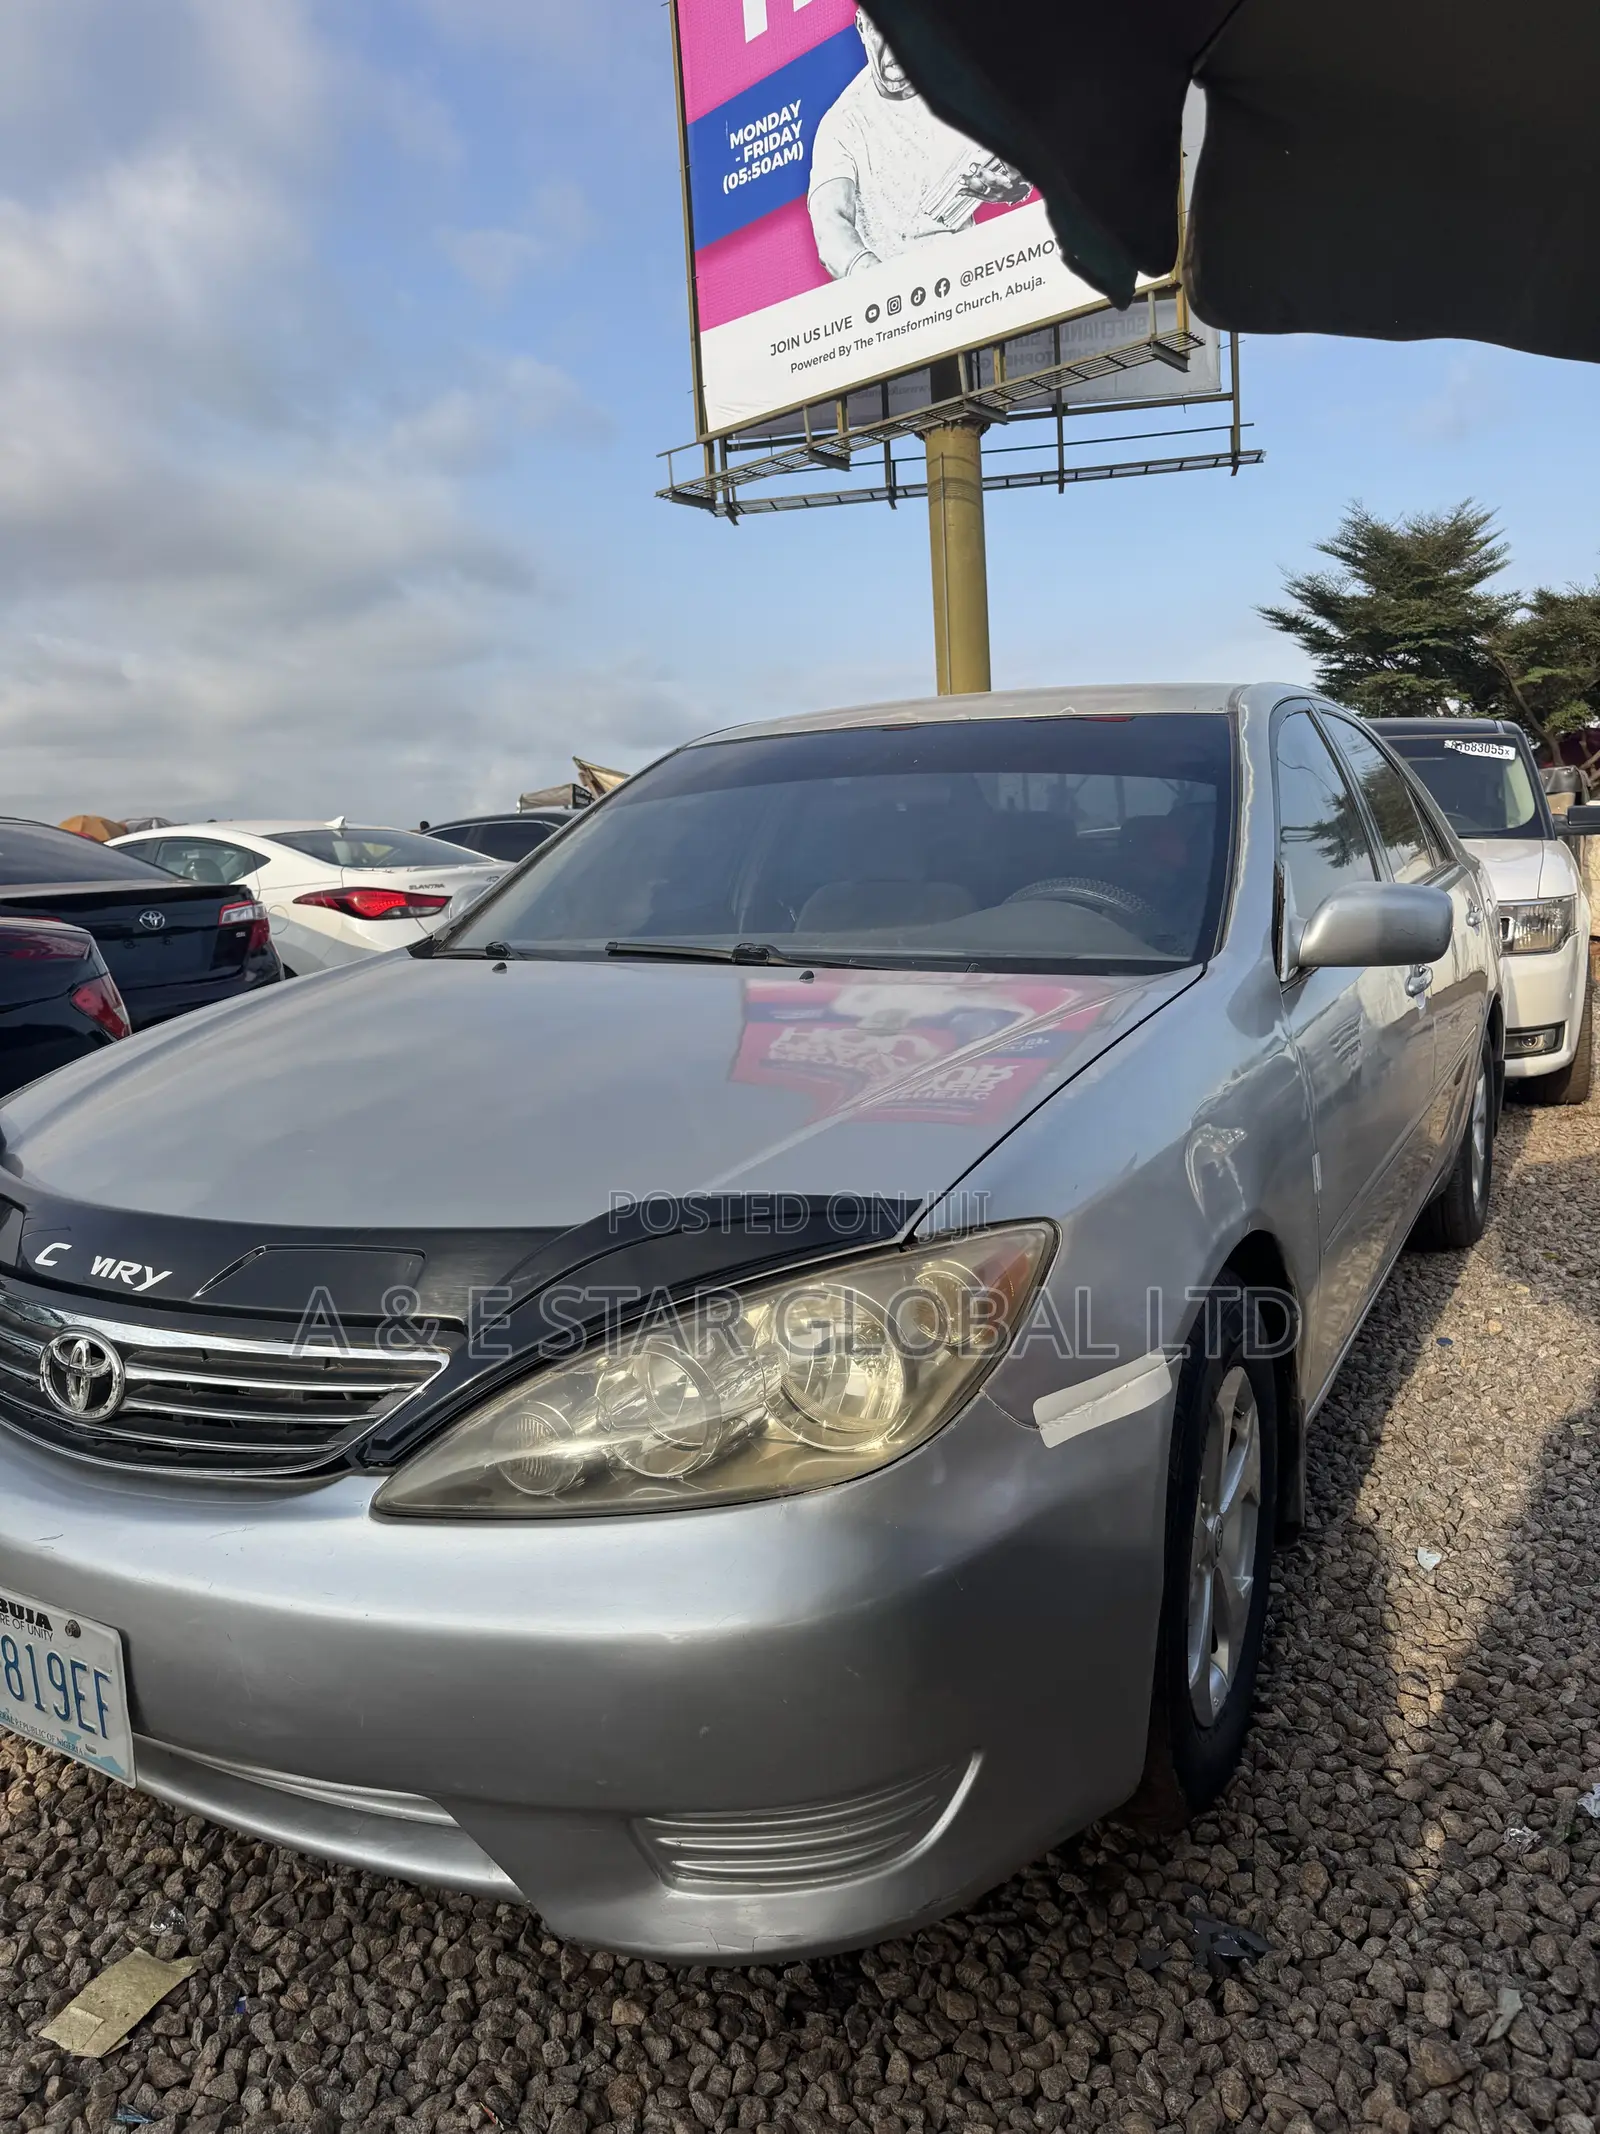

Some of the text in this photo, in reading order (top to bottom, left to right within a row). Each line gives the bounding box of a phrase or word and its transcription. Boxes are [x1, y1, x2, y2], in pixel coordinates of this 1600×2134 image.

[730, 99, 802, 150] MONDAY
[743, 119, 803, 163] FRIDAY
[723, 141, 804, 194] (05:50AM)
[770, 335, 800, 356] JOIN
[804, 328, 821, 344] US
[824, 316, 853, 337] LIVE
[790, 276, 1046, 373] Powered By The Transforming Church, Abuja.
[12, 1618, 25, 1631] OF
[27, 1623, 54, 1642] UNITY
[1, 1634, 112, 1740] 819EF
